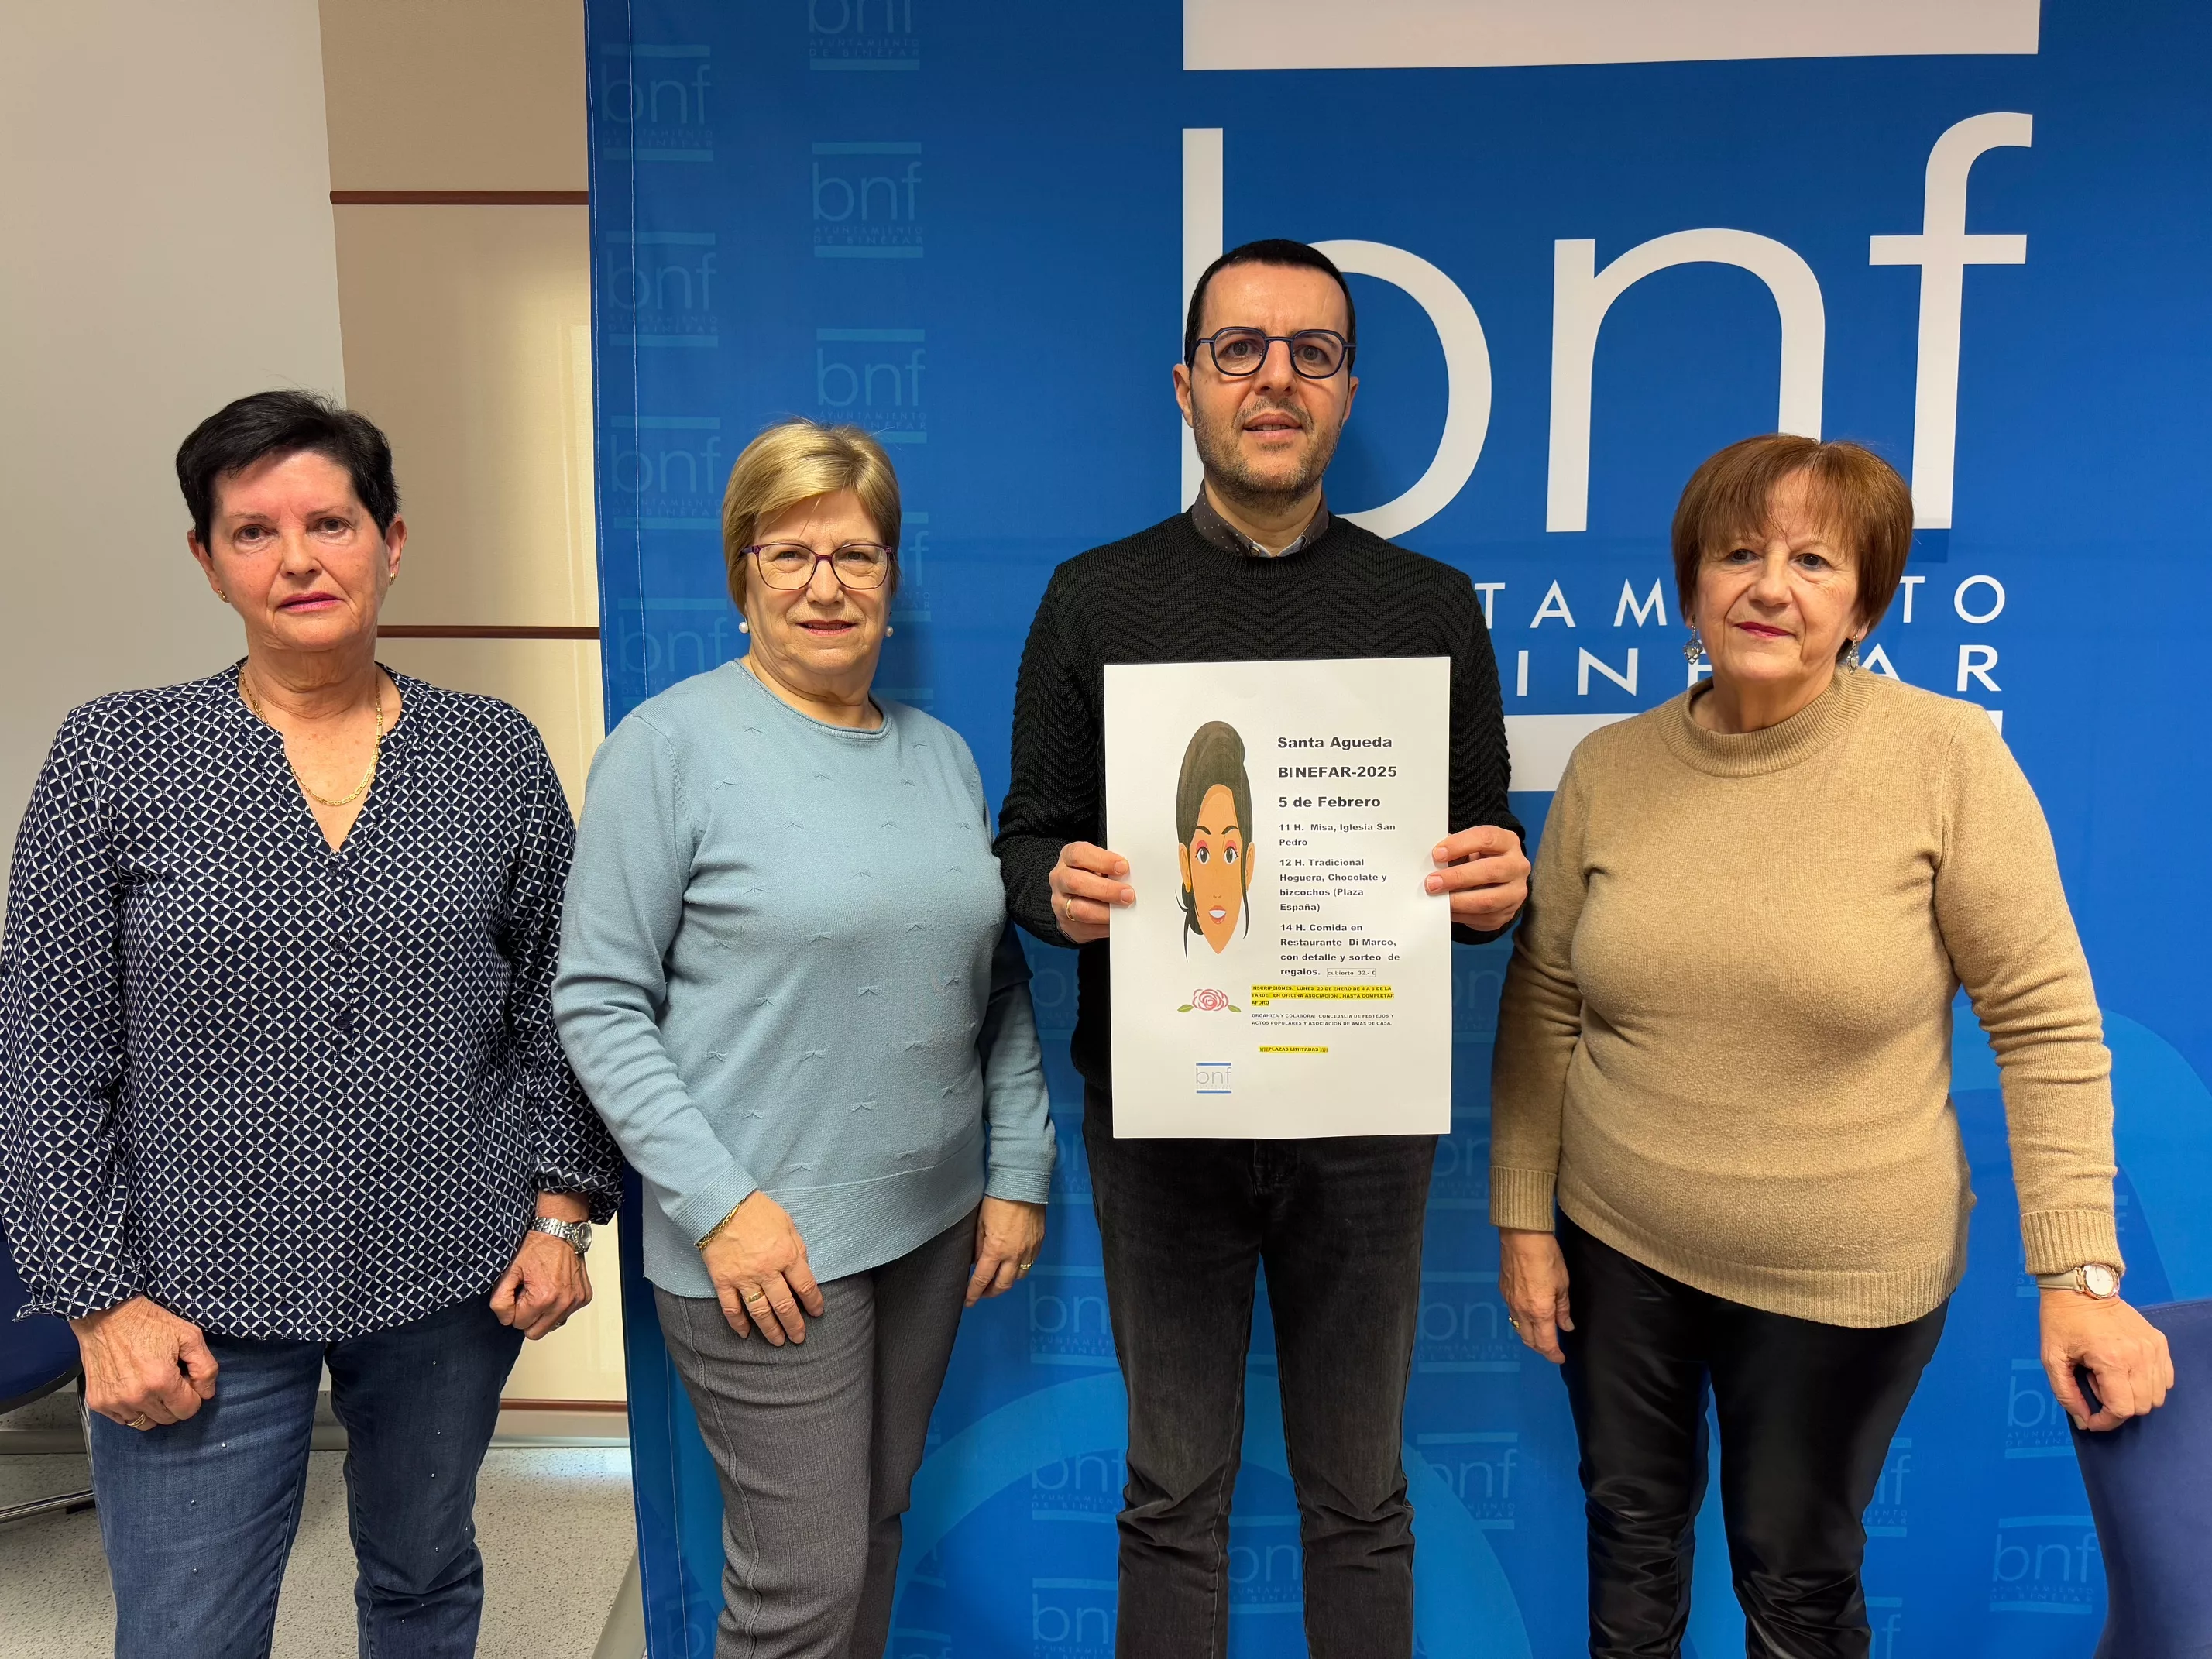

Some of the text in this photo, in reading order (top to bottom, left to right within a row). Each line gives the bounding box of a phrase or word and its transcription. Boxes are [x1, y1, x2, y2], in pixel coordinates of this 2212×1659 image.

[812, 160, 922, 222] bnf
[606, 249, 717, 311] bnf
[1182, 111, 2033, 538] bnf
[816, 347, 926, 407] bnf
[610, 434, 722, 494] bnf
[619, 617, 730, 673] bnf
[1277, 736, 1393, 751] Santa Agueda
[1278, 765, 1397, 778] BINEFAR-2025
[1278, 795, 1381, 808] 5 de Febrero
[1279, 823, 1290, 832] 11
[1310, 823, 1337, 833] Misa,
[1339, 823, 1373, 833] Iglesia
[1376, 823, 1396, 831] San
[1279, 838, 1308, 847] Pedro
[1279, 858, 1365, 867] 12 H. Tradicional
[1279, 874, 1325, 884] Hoguera,
[1328, 873, 1379, 881] Chocolate
[1279, 888, 1364, 898] bizcochos (Plaza
[1279, 903, 1321, 913] España)
[1280, 923, 1293, 932] 14
[1295, 923, 1307, 932] H.
[1309, 923, 1348, 932] Comida
[1280, 938, 1396, 947] Restaurante Di Marco,
[1301, 953, 1337, 961] detalle
[1387, 953, 1400, 961] de
[1280, 967, 1321, 977] regalos.
[1195, 1066, 1232, 1084] bnf
[1991, 1533, 2097, 1584] bnf
